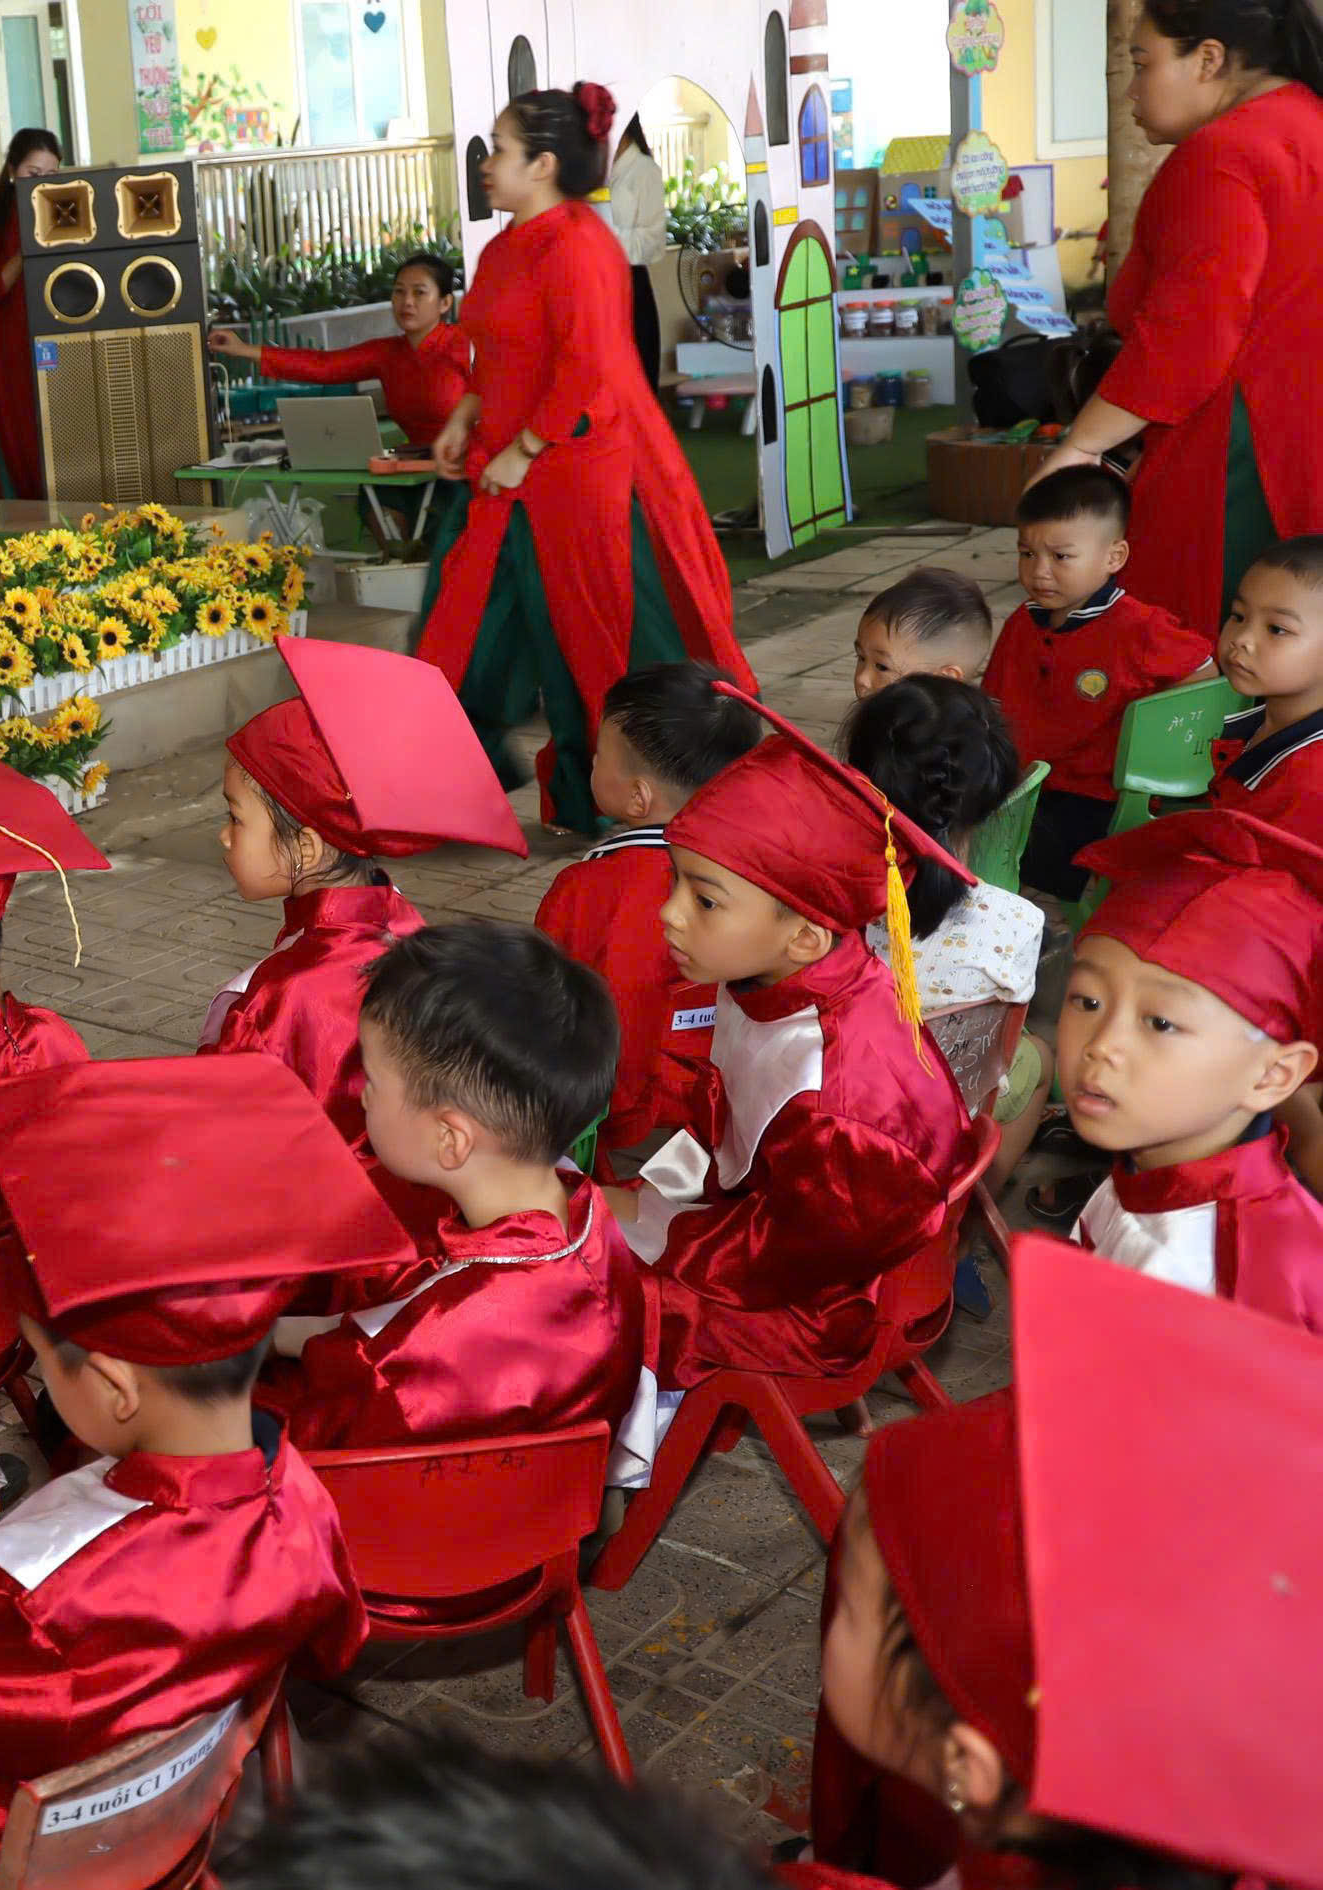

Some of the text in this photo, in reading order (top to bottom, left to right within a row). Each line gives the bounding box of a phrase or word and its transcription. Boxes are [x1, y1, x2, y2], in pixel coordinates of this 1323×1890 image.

[675, 1014, 695, 1026] 3-4
[46, 1735, 215, 1828] 3-4 tuổi C1 Trung
